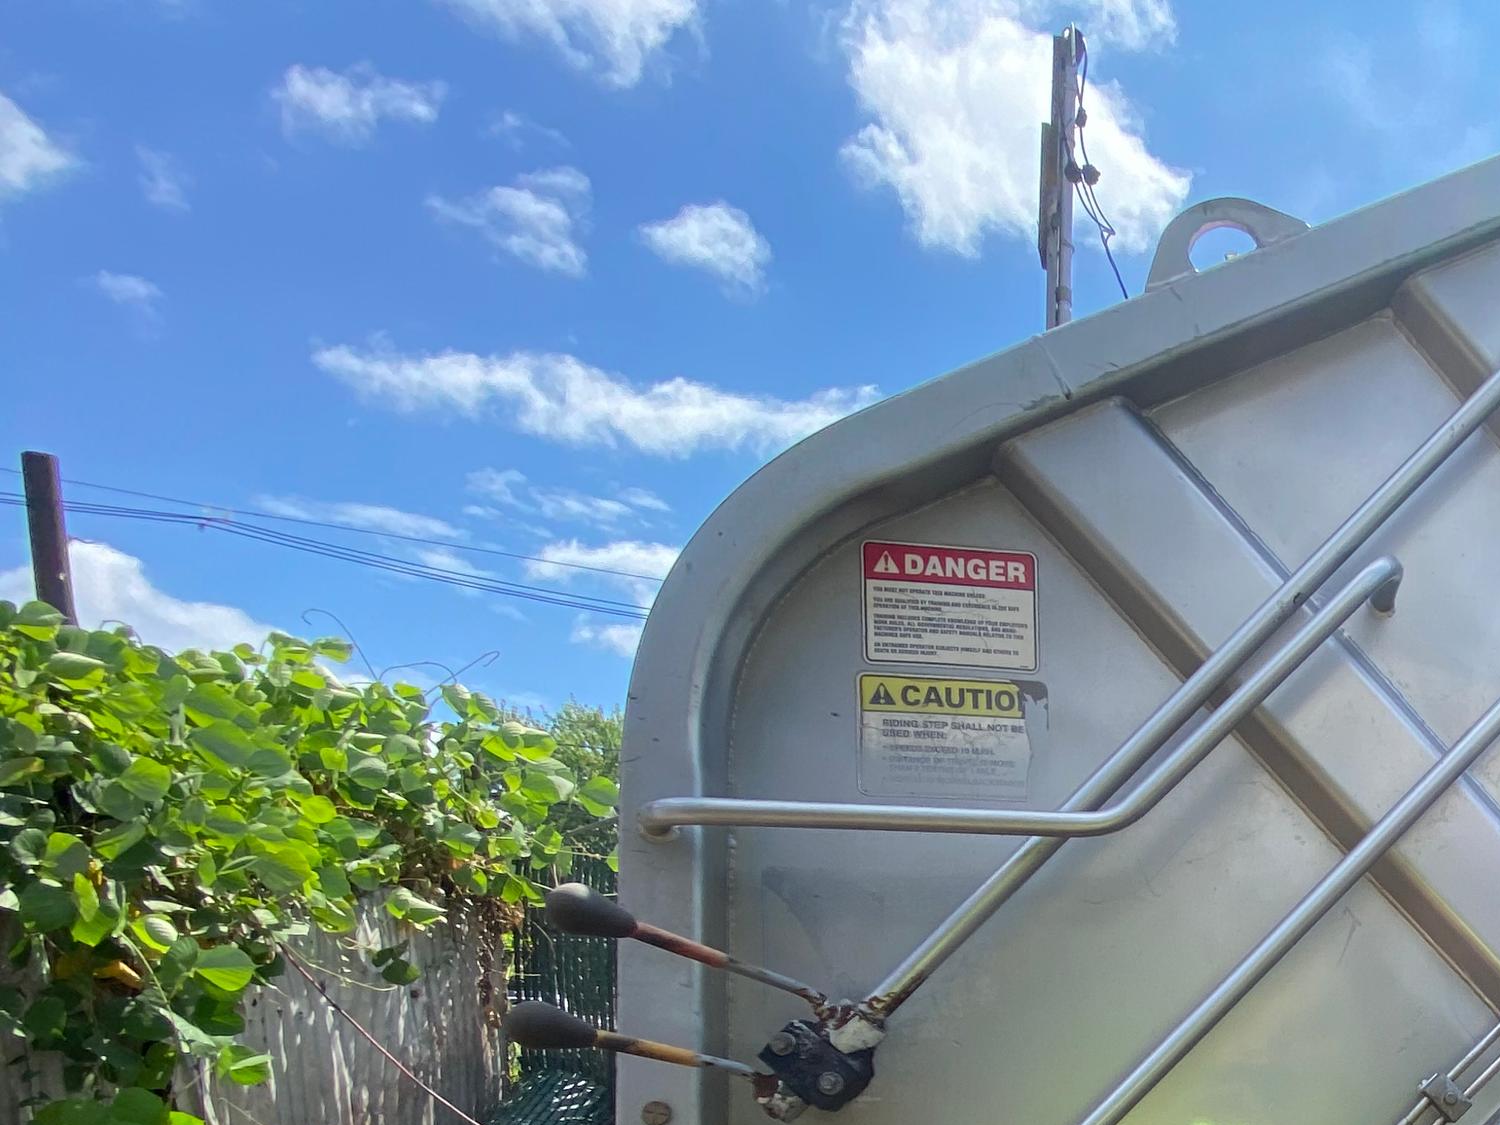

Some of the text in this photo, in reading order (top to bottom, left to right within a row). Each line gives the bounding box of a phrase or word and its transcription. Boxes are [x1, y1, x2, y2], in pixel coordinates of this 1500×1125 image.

[904, 553, 1026, 583] DANGER
[901, 685, 1023, 712] CAUTIO
[882, 718, 1025, 733] RIDING STEP SHALL NOT BE
